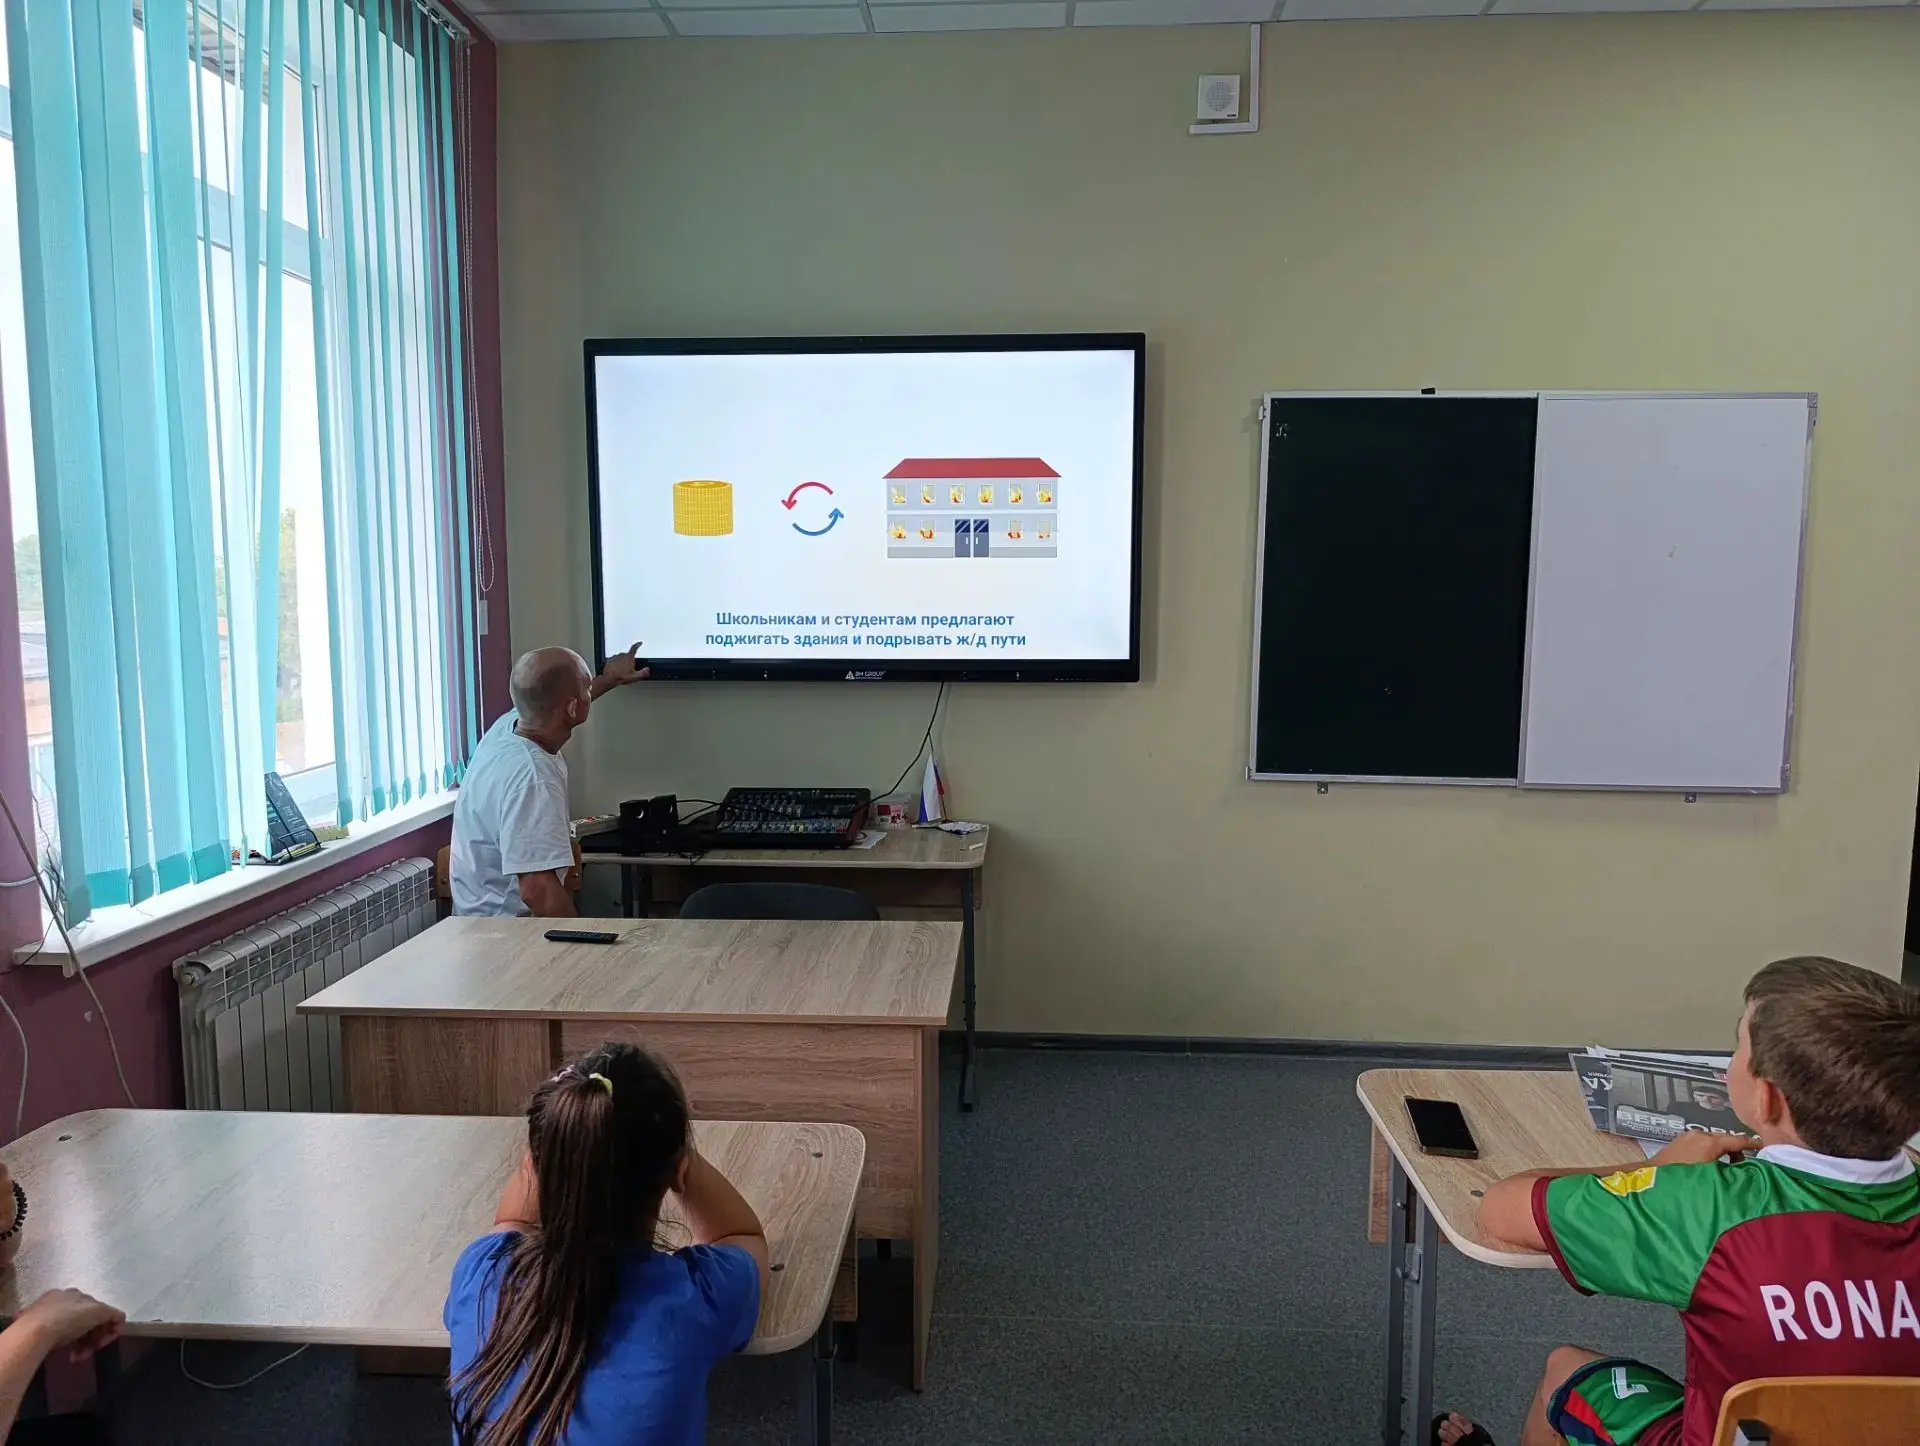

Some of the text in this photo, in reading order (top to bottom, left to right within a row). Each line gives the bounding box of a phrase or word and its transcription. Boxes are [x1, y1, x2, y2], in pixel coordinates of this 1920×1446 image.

[716, 612, 1015, 629] Школьникам и студентам предлагают
[705, 632, 1026, 649] поджигать здания и подрывать ж/д пути
